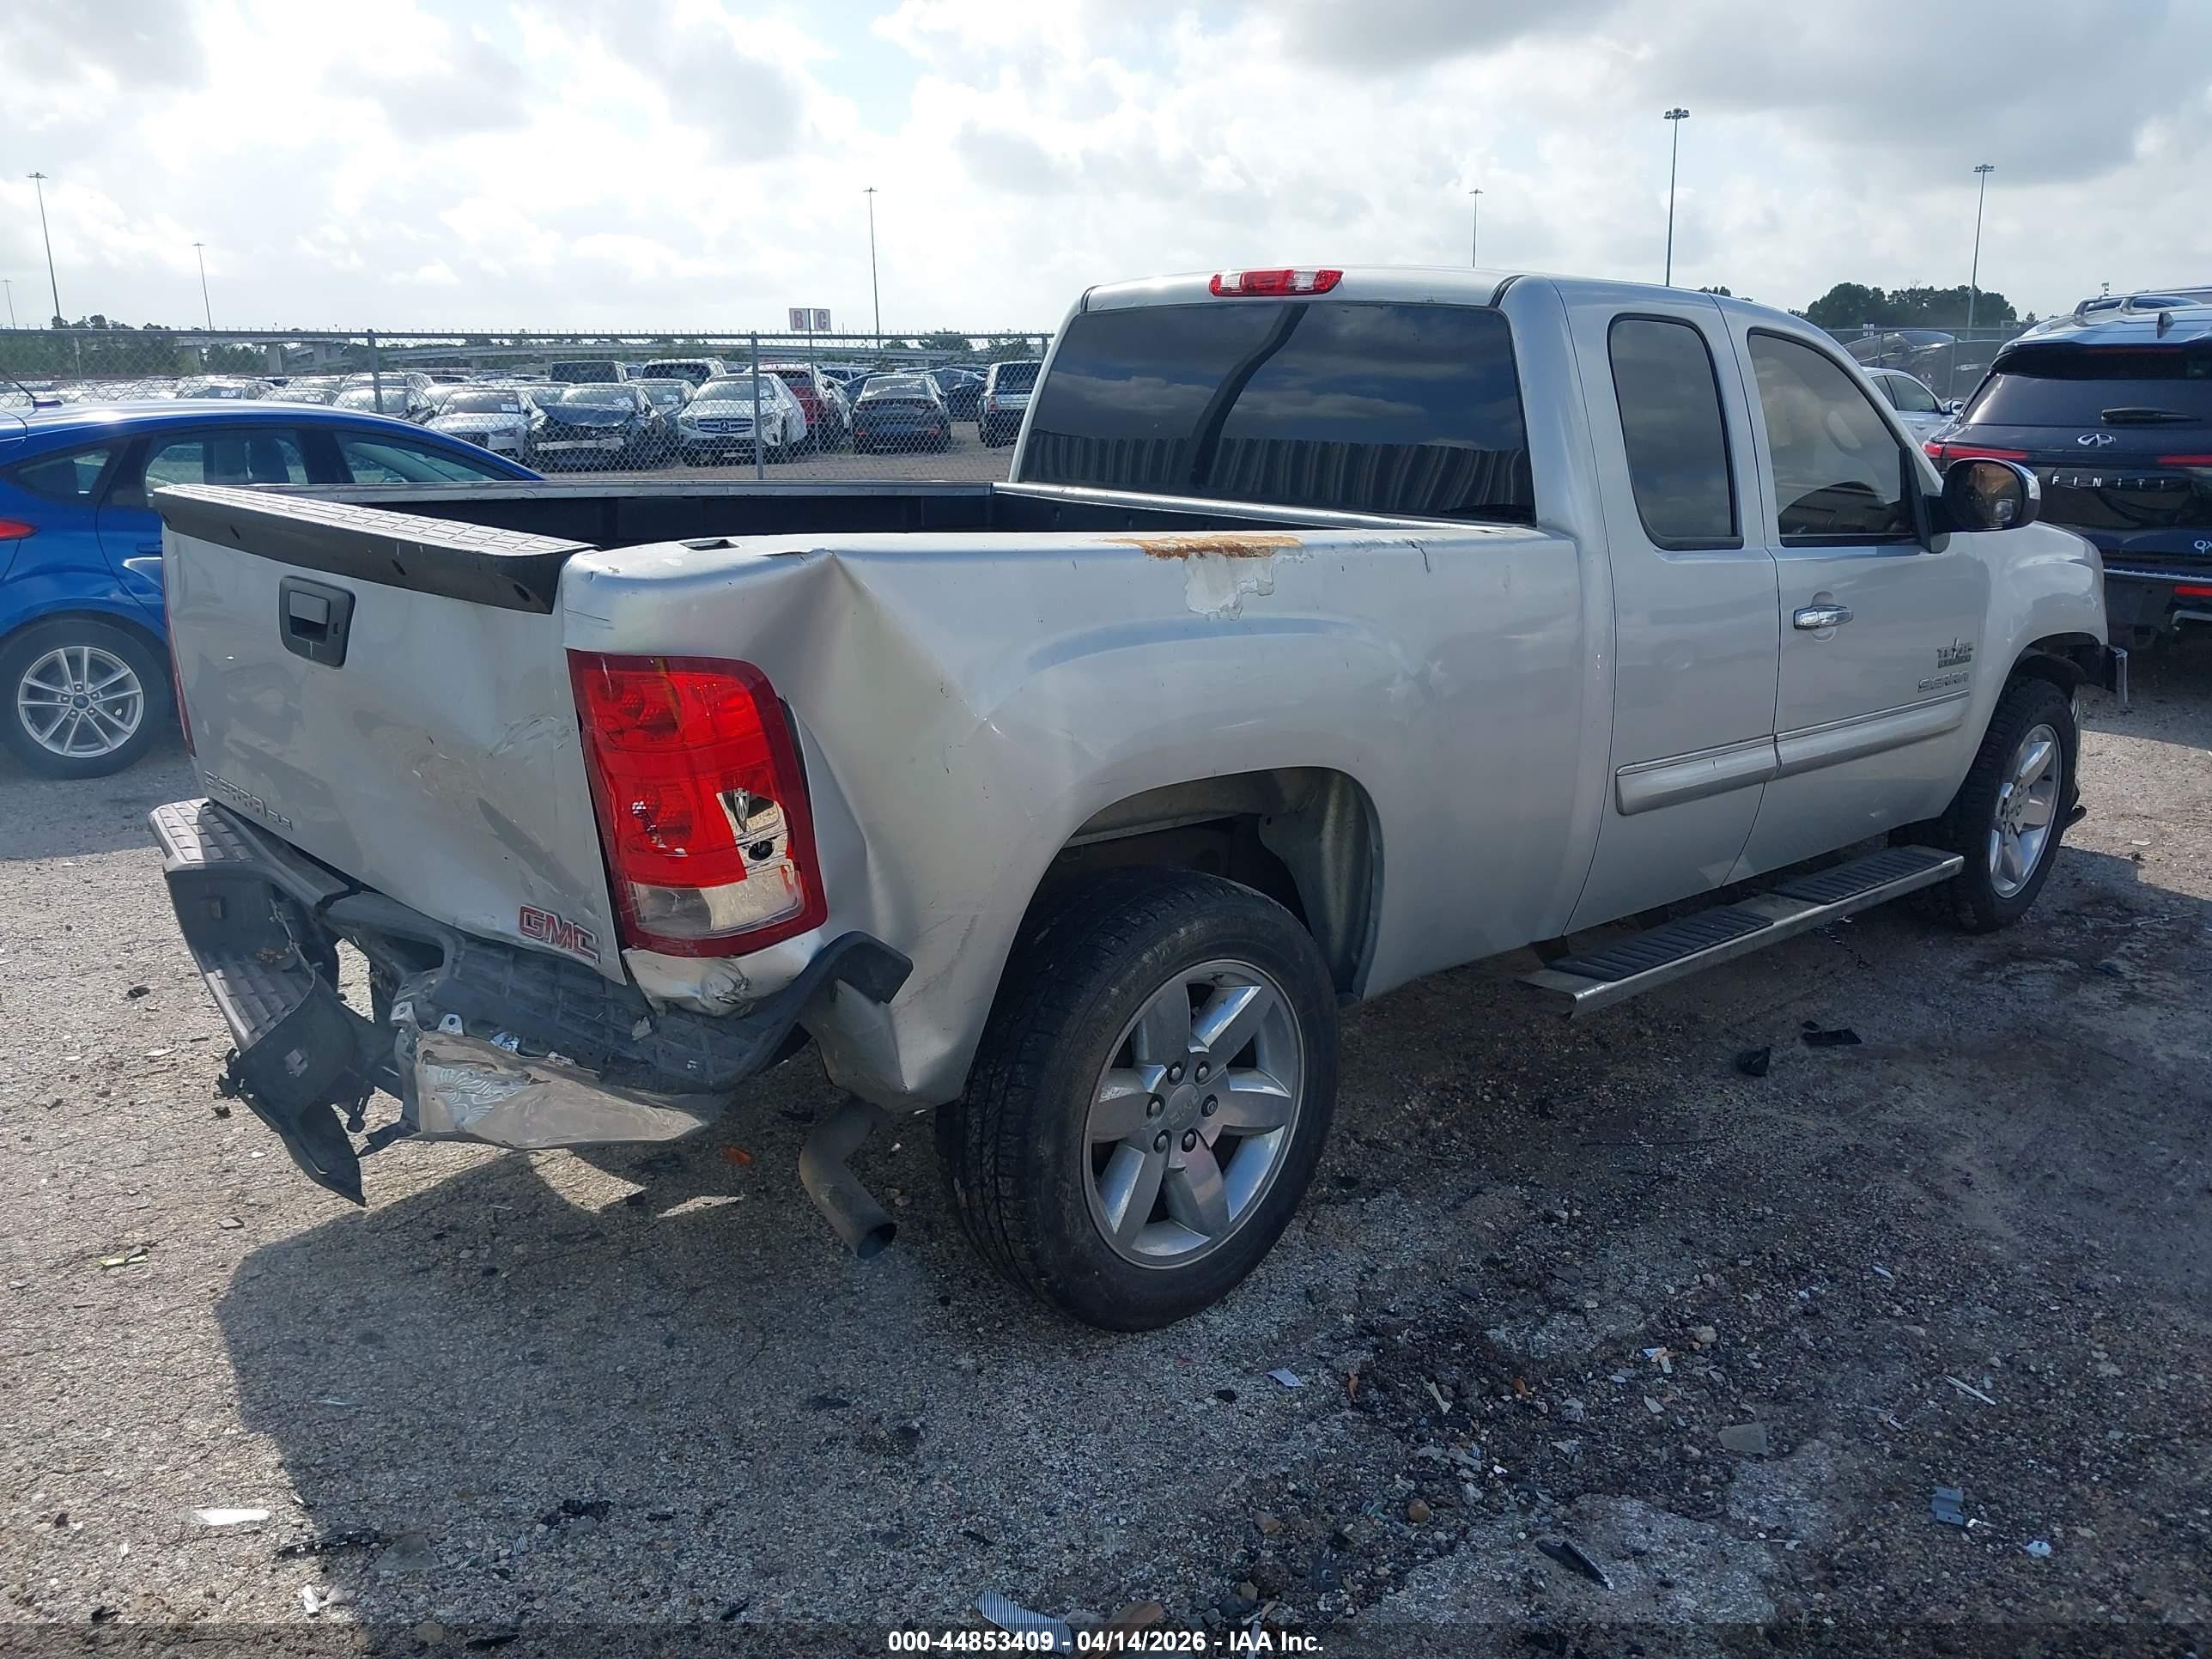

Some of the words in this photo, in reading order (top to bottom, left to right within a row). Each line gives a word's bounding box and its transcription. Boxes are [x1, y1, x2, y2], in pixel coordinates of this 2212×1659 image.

[793, 311, 804, 329] B
[817, 311, 827, 329] C
[2035, 475, 2165, 488] FINITI
[519, 904, 600, 963] GMC
